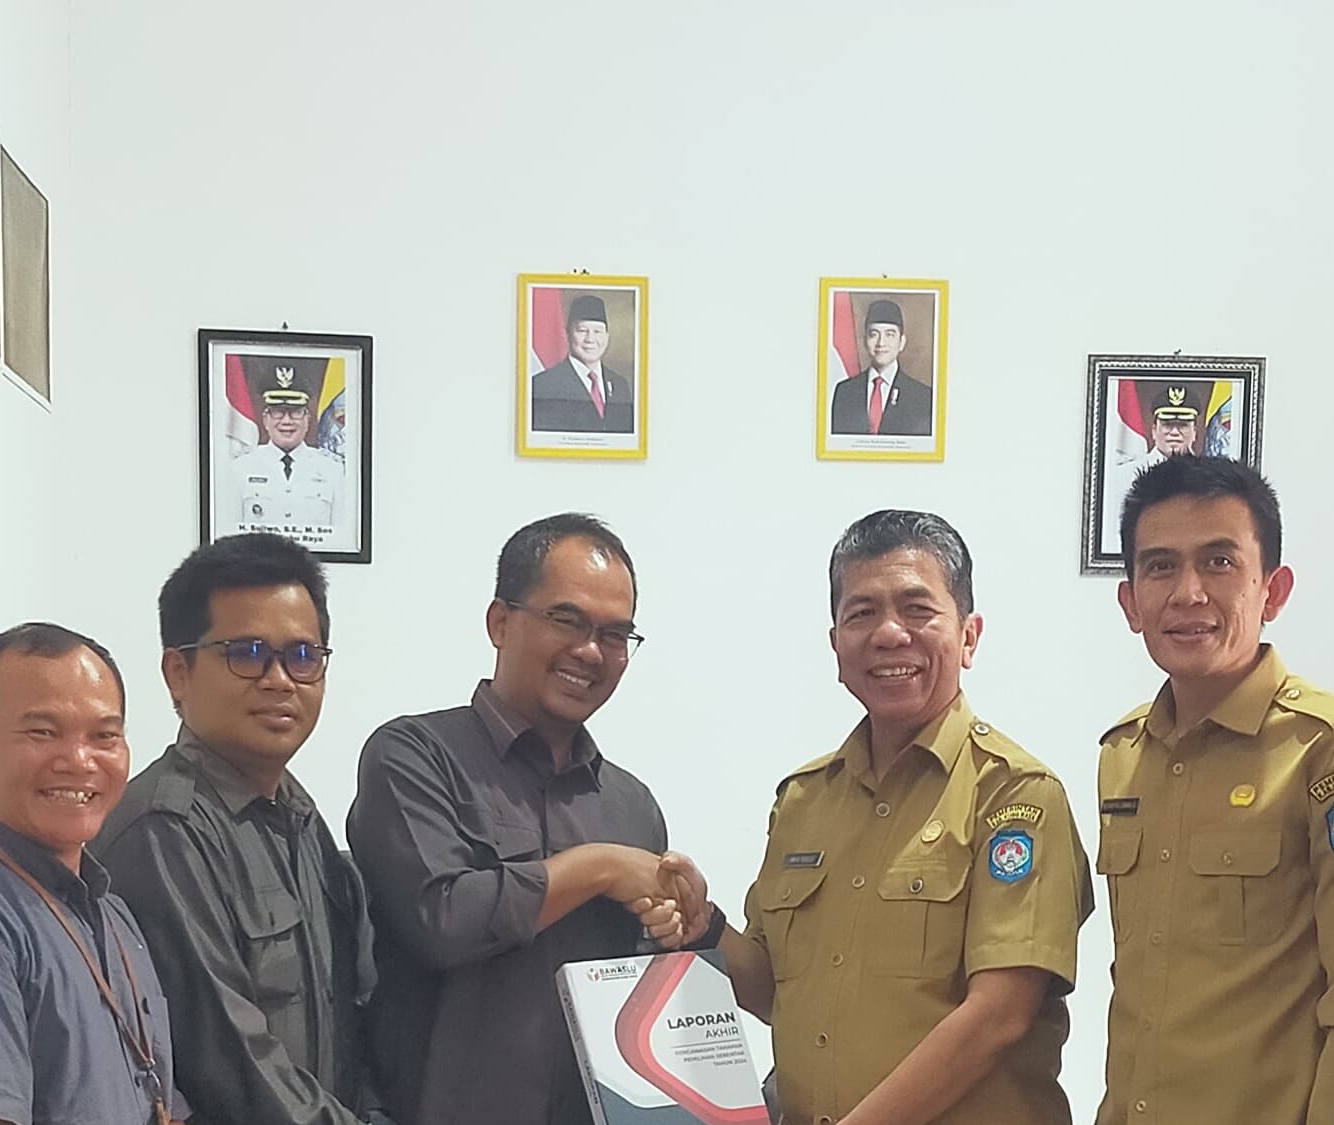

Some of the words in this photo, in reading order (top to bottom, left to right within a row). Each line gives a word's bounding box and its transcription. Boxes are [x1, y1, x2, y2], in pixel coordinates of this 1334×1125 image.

[599, 965, 637, 977] BAWASLU
[667, 1011, 736, 1029] LAPORAN
[706, 1026, 739, 1039] AKHIR
